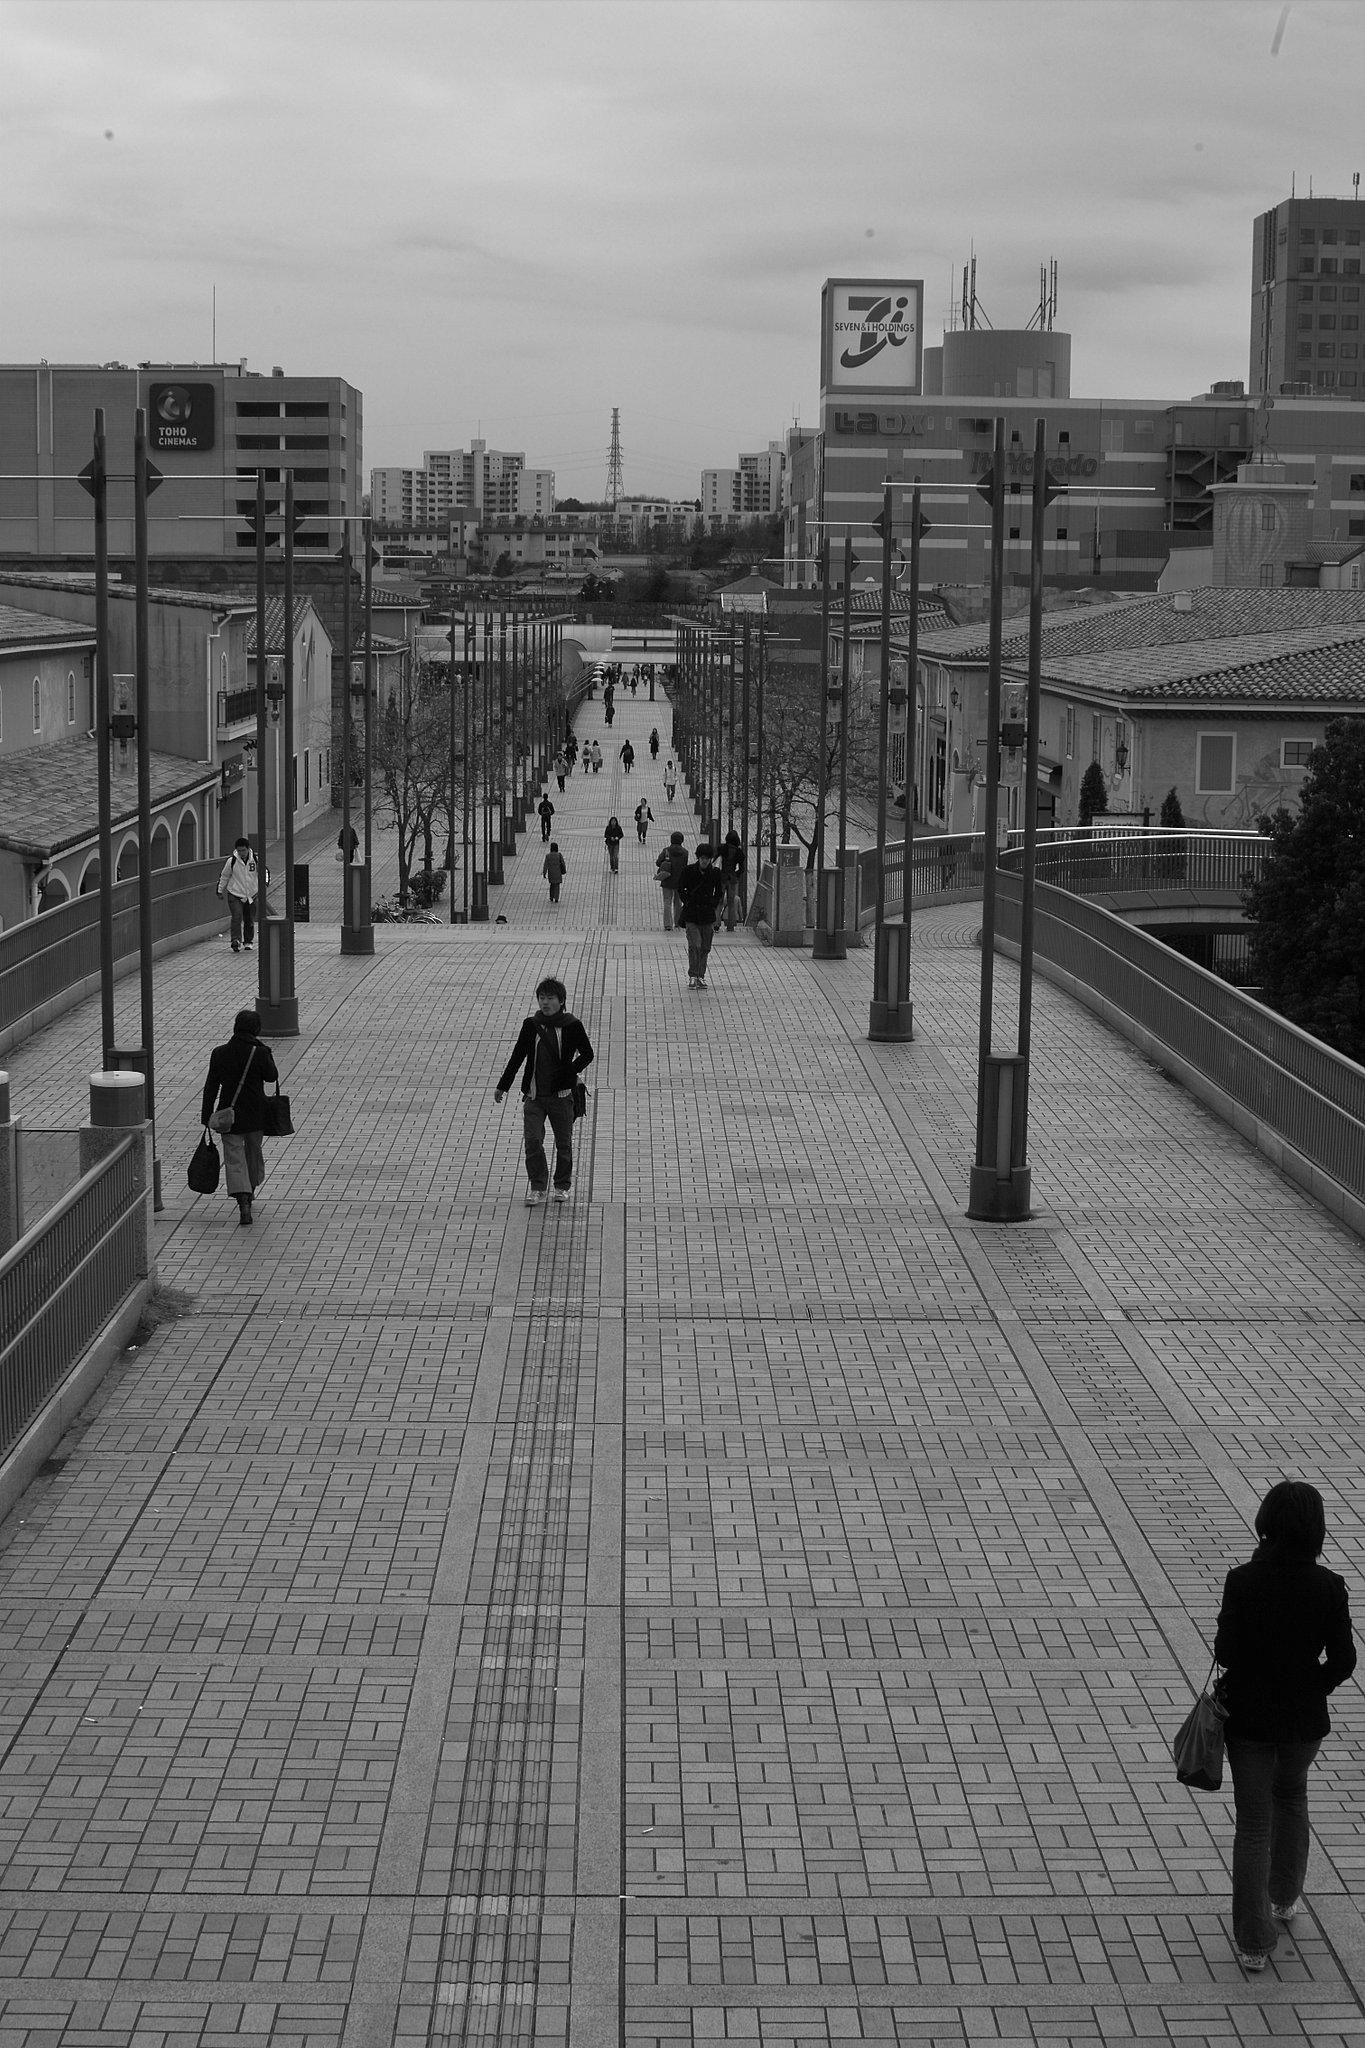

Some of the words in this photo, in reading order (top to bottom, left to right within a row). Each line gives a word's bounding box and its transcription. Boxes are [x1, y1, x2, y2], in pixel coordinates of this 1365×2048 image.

[872, 323, 915, 333] HOLDINGS
[158, 427, 187, 436] TOHO
[158, 437, 197, 446] CINEMAS
[1006, 451, 1099, 478] Yoado
[249, 863, 255, 871] B
